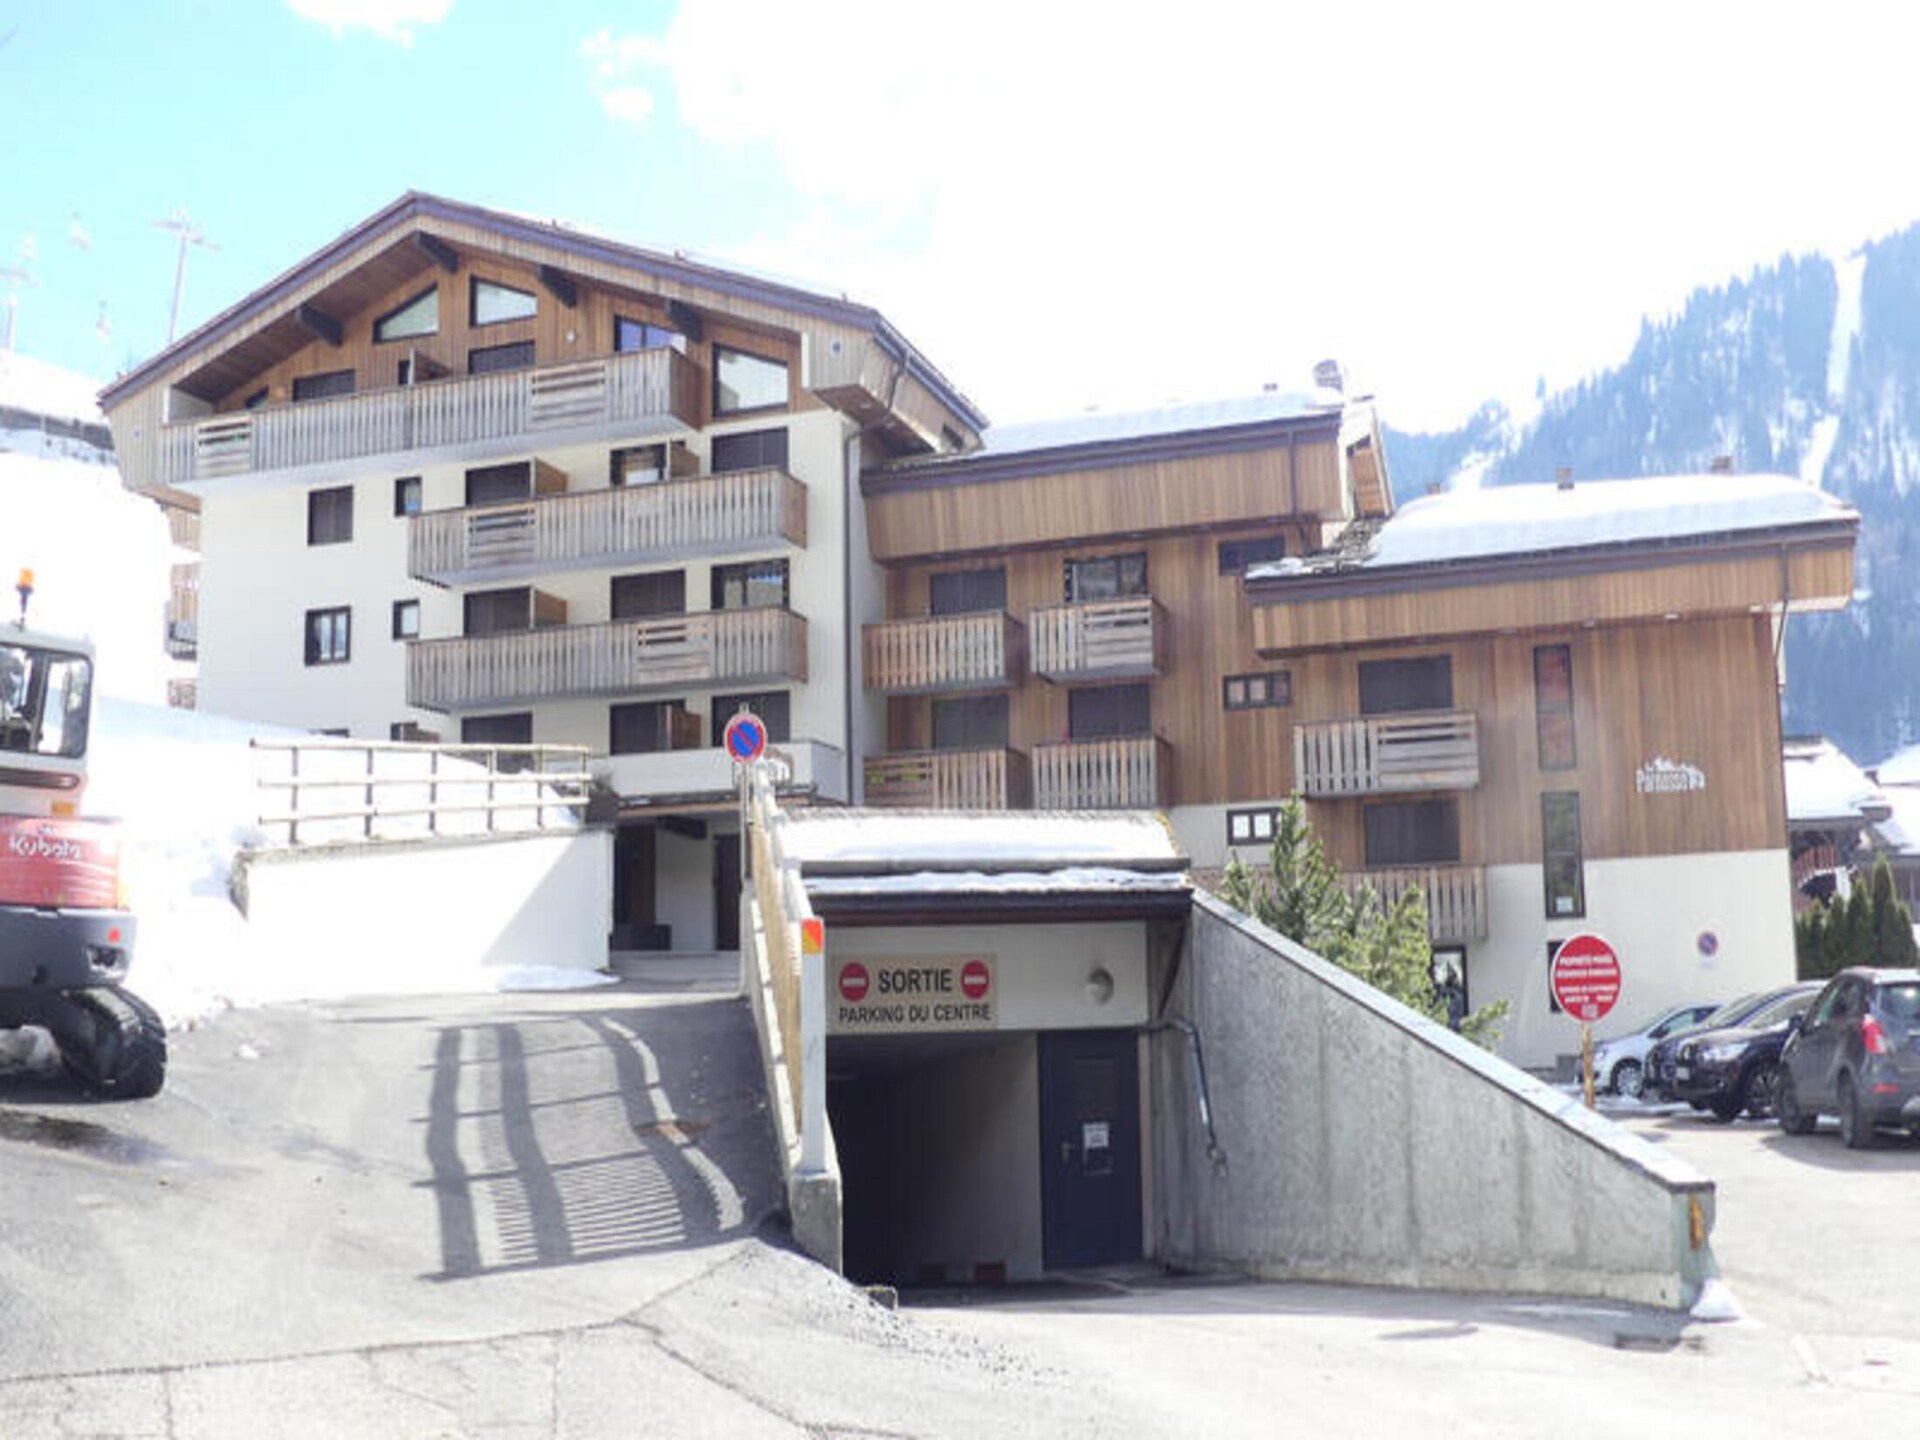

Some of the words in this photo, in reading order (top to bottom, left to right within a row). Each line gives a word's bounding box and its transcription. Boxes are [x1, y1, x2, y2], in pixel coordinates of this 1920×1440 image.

[9, 834, 81, 860] Kubota
[878, 968, 952, 994] SORTIE
[839, 1004, 904, 1024] PARKING
[909, 1005, 929, 1023] DU
[933, 1003, 992, 1021] CENTRE
